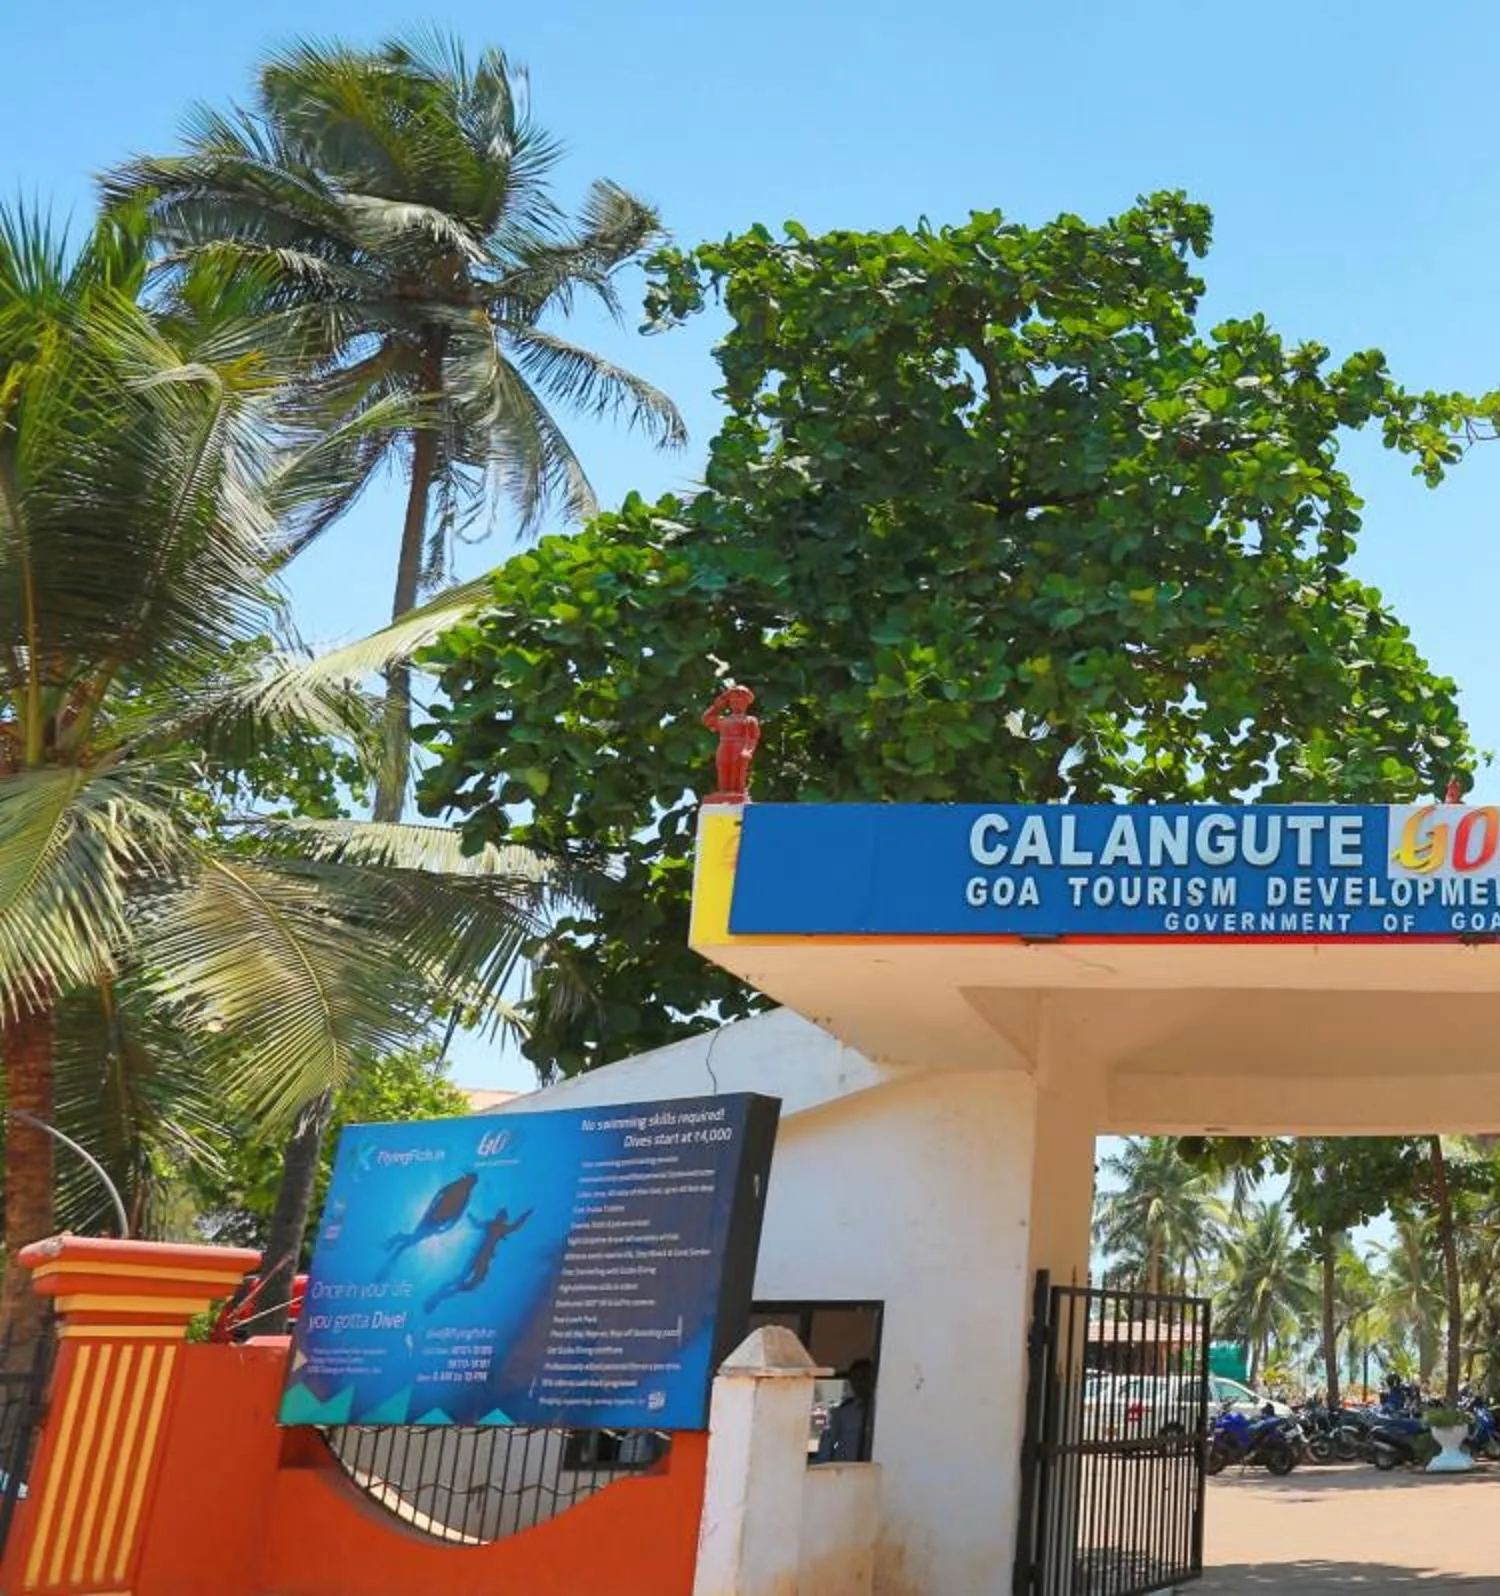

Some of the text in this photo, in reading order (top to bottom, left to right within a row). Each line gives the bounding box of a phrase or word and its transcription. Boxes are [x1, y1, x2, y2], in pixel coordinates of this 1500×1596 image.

[968, 813, 1363, 867] CALANGUTE
[966, 877, 1039, 906] GOA
[1069, 876, 1236, 907] TOURISM
[1165, 912, 1350, 932] GOVERNMENT
[1383, 913, 1415, 933] OF
[581, 1108, 725, 1131] No swimming skills required!
[624, 1134, 652, 1148] Dives
[655, 1132, 678, 1145] start
[681, 1131, 693, 1143] at
[311, 1280, 344, 1298] Once
[307, 1311, 407, 1334] you gotta Dive!
